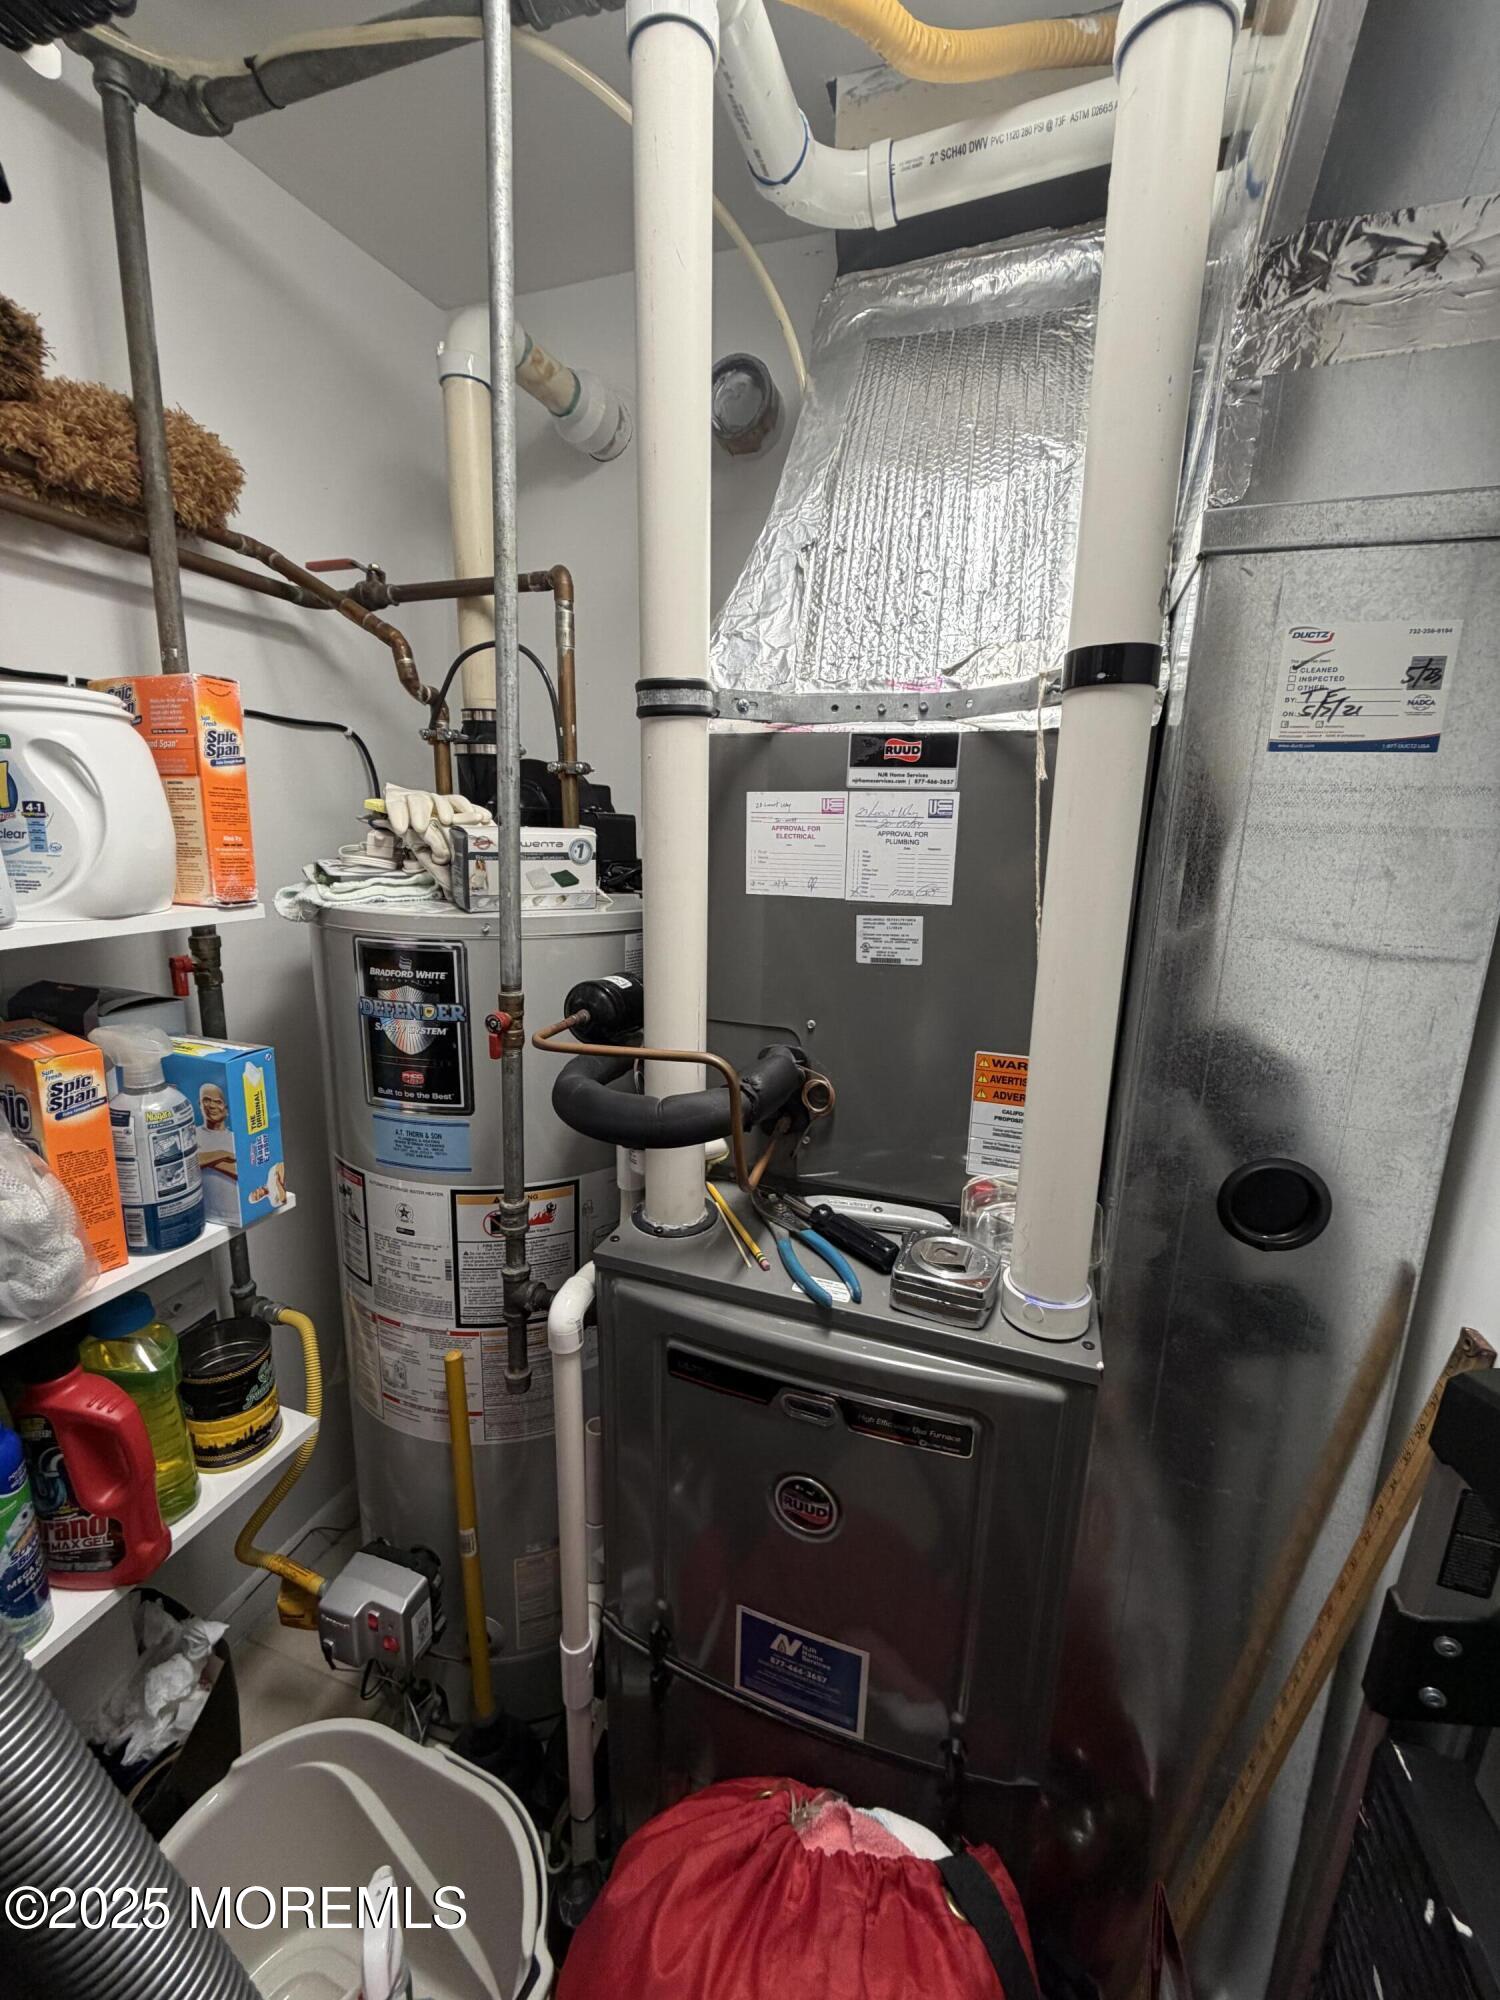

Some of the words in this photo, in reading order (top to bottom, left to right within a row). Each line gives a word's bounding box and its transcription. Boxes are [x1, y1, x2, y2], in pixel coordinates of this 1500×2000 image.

[940, 143, 967, 161] SCH40
[968, 136, 989, 153] DWV
[990, 133, 1005, 147] PVC
[1069, 108, 1090, 124] ASTM
[1291, 630, 1330, 639] DUCTZ
[206, 730, 237, 746] Spic
[205, 743, 241, 758] Span
[885, 746, 920, 754] RUUD
[370, 967, 414, 978] BRADFORD
[416, 970, 447, 980] WHITE
[360, 998, 466, 1021] DEFENDER
[992, 1059, 1028, 1071] WAR
[50, 1075, 93, 1098] Spic
[990, 1075, 1028, 1086] AVERTIS
[377, 1087, 394, 1095] Built
[395, 1088, 403, 1096] to
[416, 1091, 430, 1099] the
[431, 1092, 453, 1100] Best
[992, 1090, 1026, 1102] ADVER
[49, 1087, 98, 1114] Span
[145, 1111, 173, 1122] Niagara
[406, 1130, 424, 1138] THORN
[430, 1132, 443, 1140] SON
[929, 1429, 961, 1442] Furnace
[783, 1494, 828, 1517] RUUD
[40, 1516, 109, 1541] rano
[51, 1540, 82, 1550] MAX
[83, 1536, 114, 1547] GEL
[6, 1566, 36, 1591] MEGA
